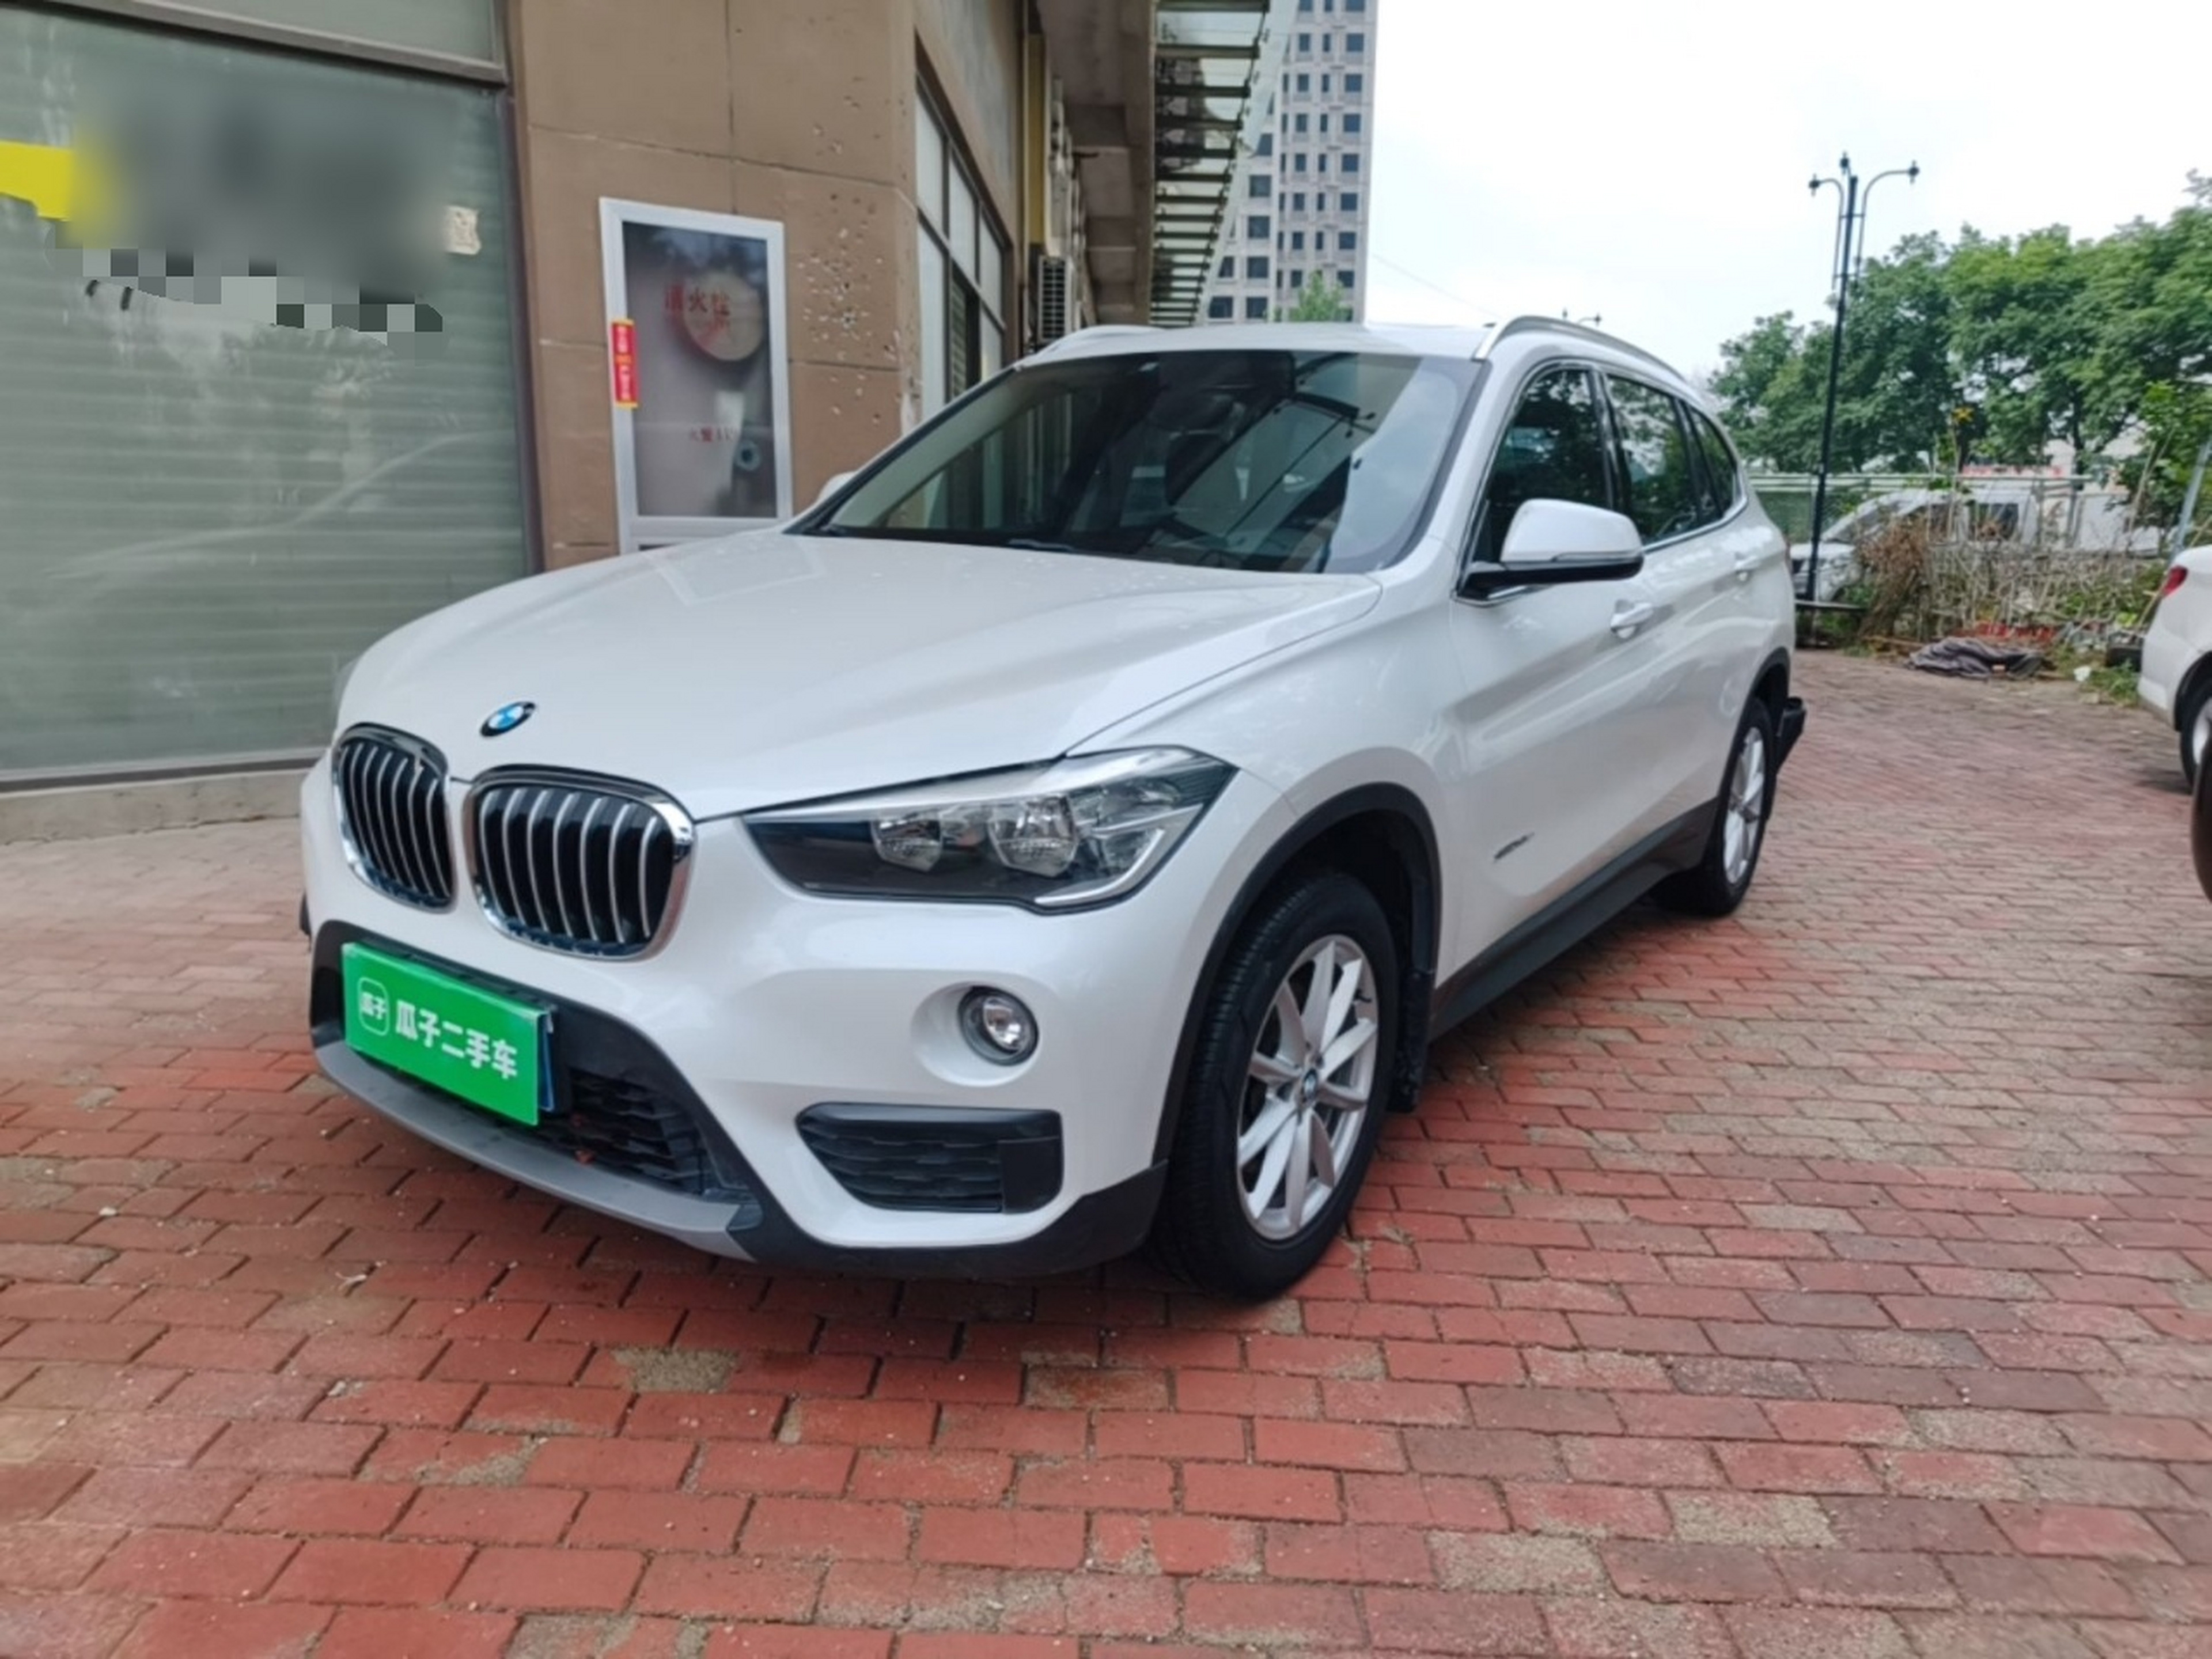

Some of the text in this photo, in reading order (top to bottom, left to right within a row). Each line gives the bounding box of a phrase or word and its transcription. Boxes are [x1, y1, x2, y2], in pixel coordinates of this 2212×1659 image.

[395, 999, 517, 1080] 瓜子二手车
